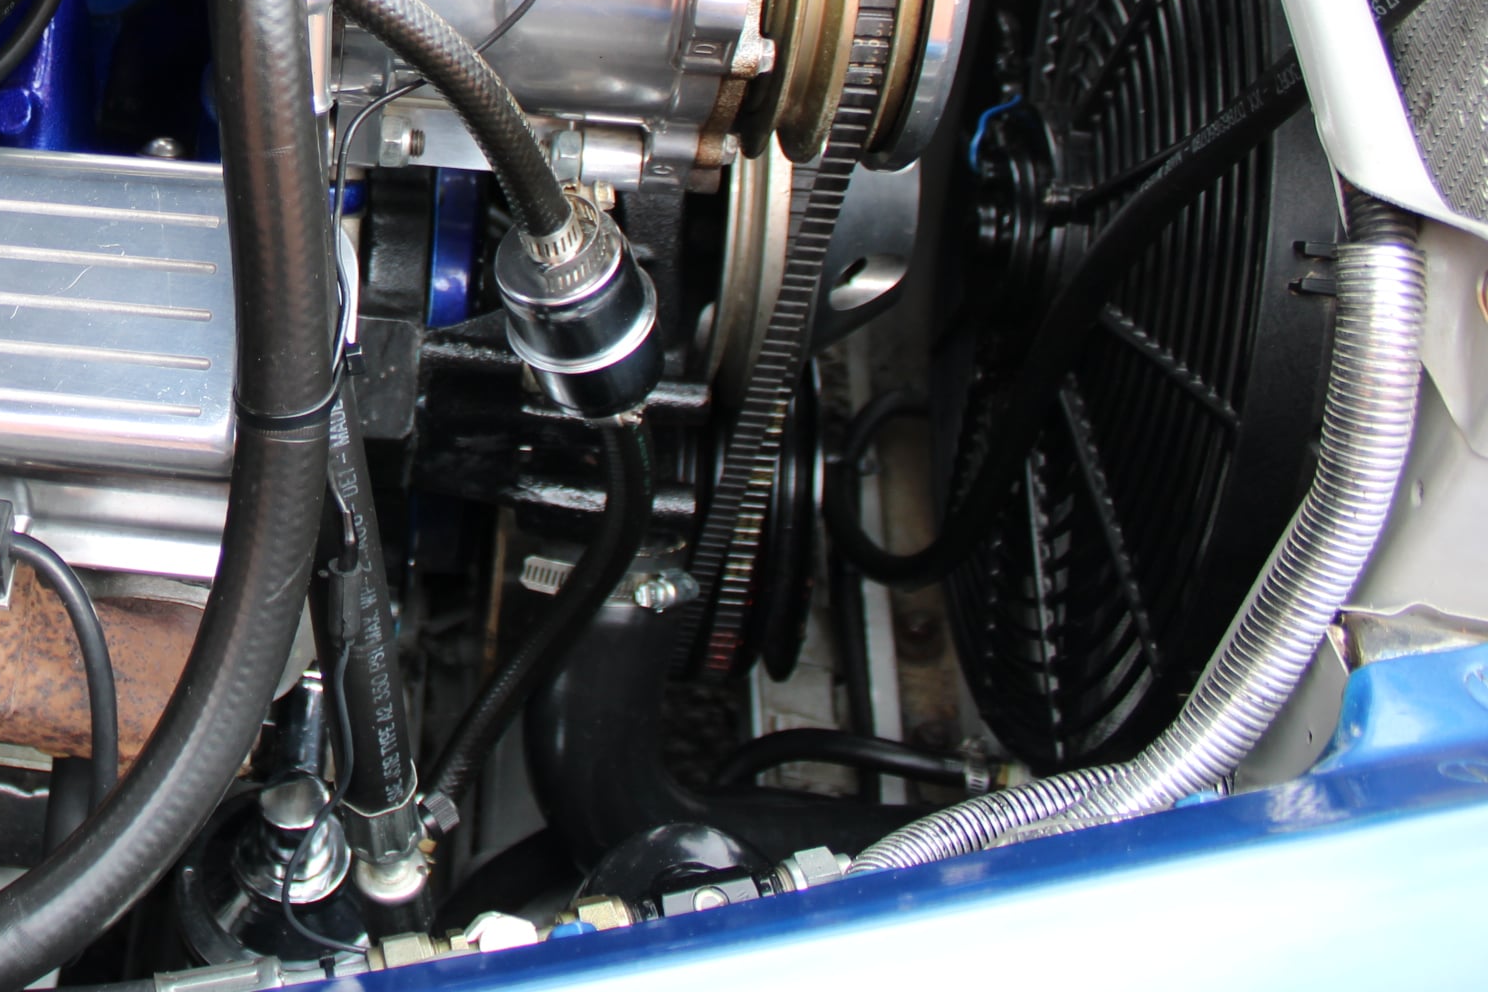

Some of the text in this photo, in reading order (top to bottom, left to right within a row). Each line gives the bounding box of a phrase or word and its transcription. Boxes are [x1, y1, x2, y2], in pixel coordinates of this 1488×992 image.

[371, 673, 390, 704] 350
[375, 702, 393, 722] A2
[378, 722, 397, 756] TYPE
